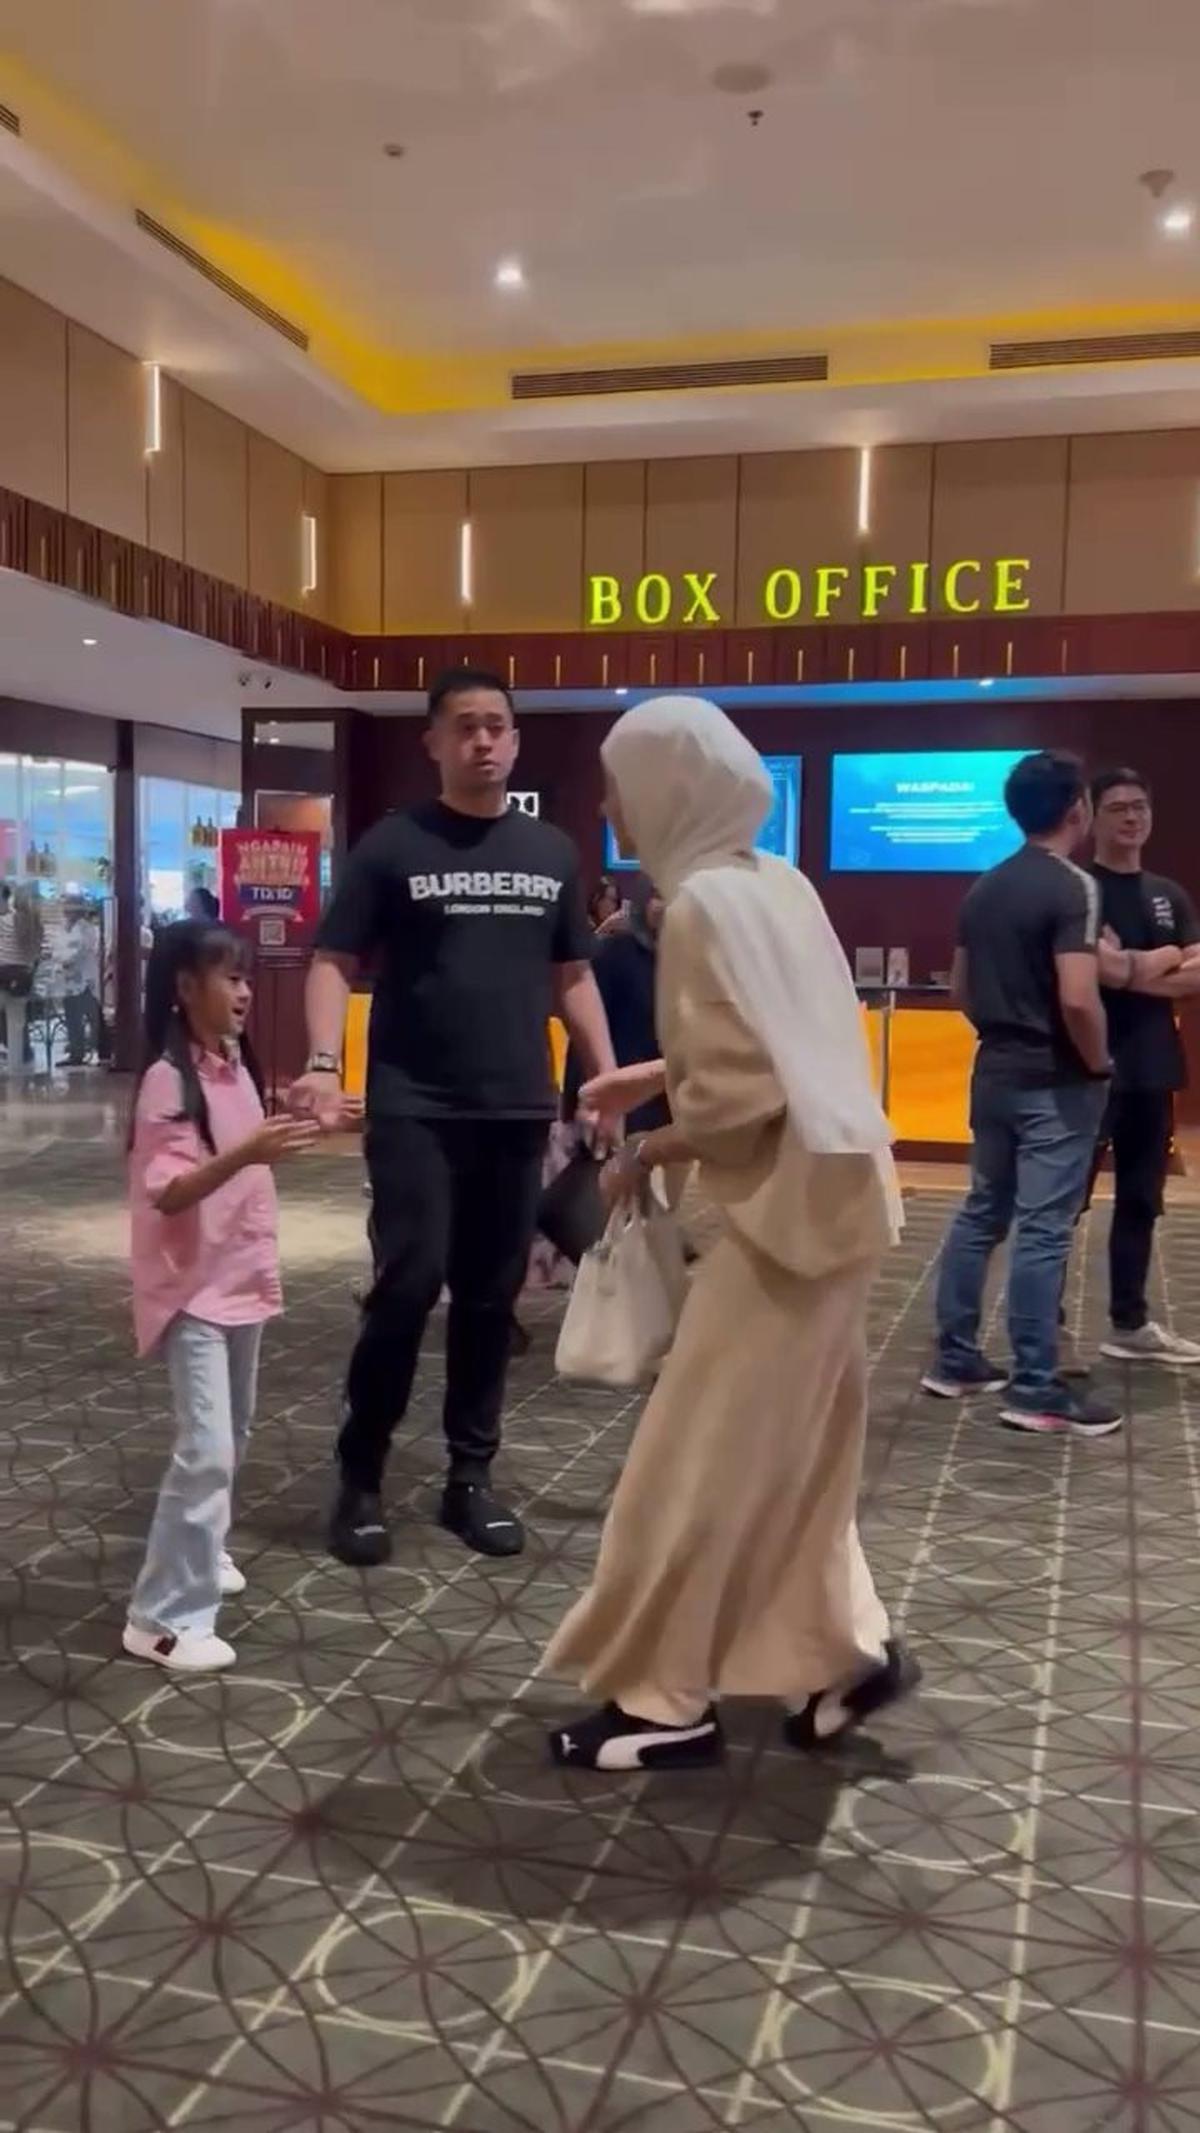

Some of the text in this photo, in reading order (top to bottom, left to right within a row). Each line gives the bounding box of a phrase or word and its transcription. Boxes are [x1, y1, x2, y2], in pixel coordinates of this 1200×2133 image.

[589, 559, 1031, 624] BOX OFFICE
[409, 872, 563, 902] BURBERRY
